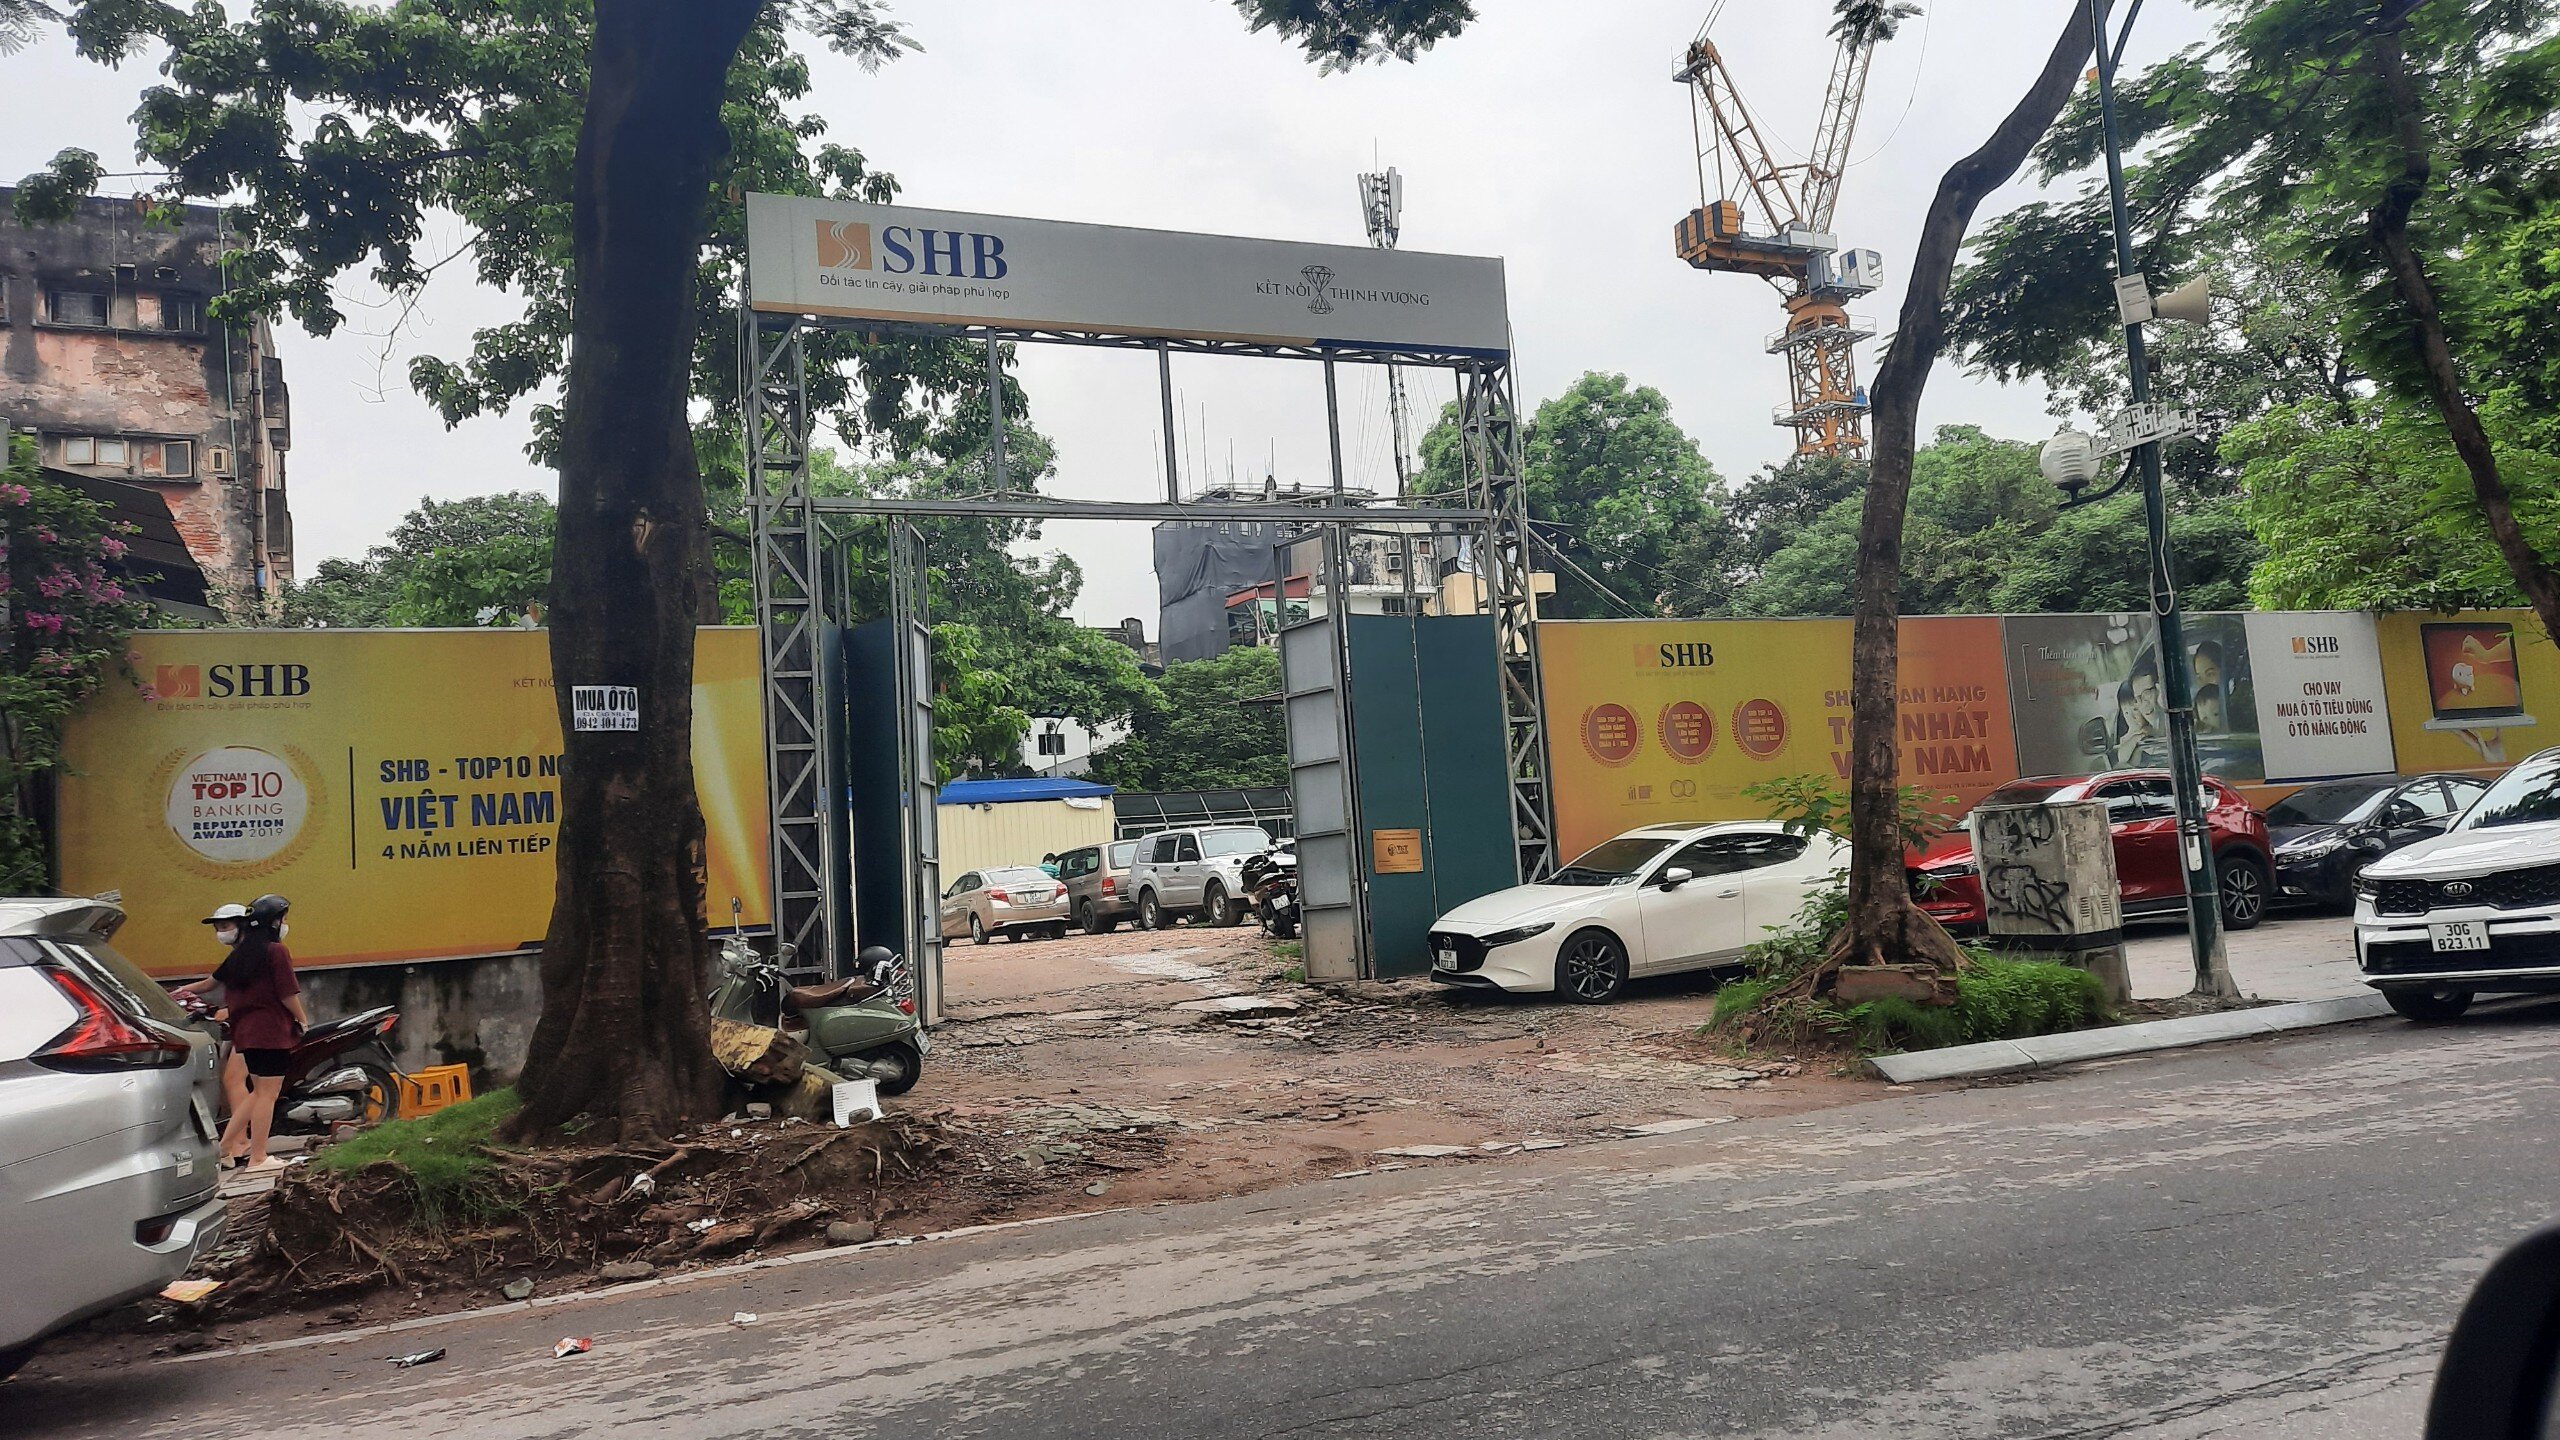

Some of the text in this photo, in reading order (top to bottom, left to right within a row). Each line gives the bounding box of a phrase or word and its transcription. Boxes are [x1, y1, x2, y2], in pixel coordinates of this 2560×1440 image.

[881, 224, 1009, 281] SHB
[865, 278, 879, 289] tin
[988, 287, 1010, 300] hợp
[1660, 642, 1714, 668] SHB
[2307, 636, 2339, 654] SHB
[208, 663, 311, 699] SHB
[2303, 680, 2341, 696] CHO VAY
[575, 689, 605, 711] MUA
[1825, 689, 1854, 708] SH
[2277, 697, 2373, 717] MUA Ô TÔ TIÊU DÙNG
[576, 717, 598, 729] 0942
[1901, 702, 1989, 742] NHẤT
[2289, 720, 2296, 737] Ô
[2297, 720, 2309, 737] TÔ
[2340, 717, 2367, 738] ĐỘNG
[380, 758, 430, 783] SHB
[455, 755, 531, 780] TOP10
[1915, 744, 1992, 775] NAM
[192, 772, 247, 783] VIETNAM
[192, 771, 283, 800] TOP 10
[193, 802, 283, 818] BANKING
[380, 788, 554, 837] VIỆT NAM
[193, 818, 284, 831] REPUTATION
[193, 827, 283, 840] AWARD 2019
[382, 832, 551, 860] 4 NĂM LIÊN TIẾP
[2445, 884, 2468, 895] KIA
[2445, 923, 2470, 937] 30G
